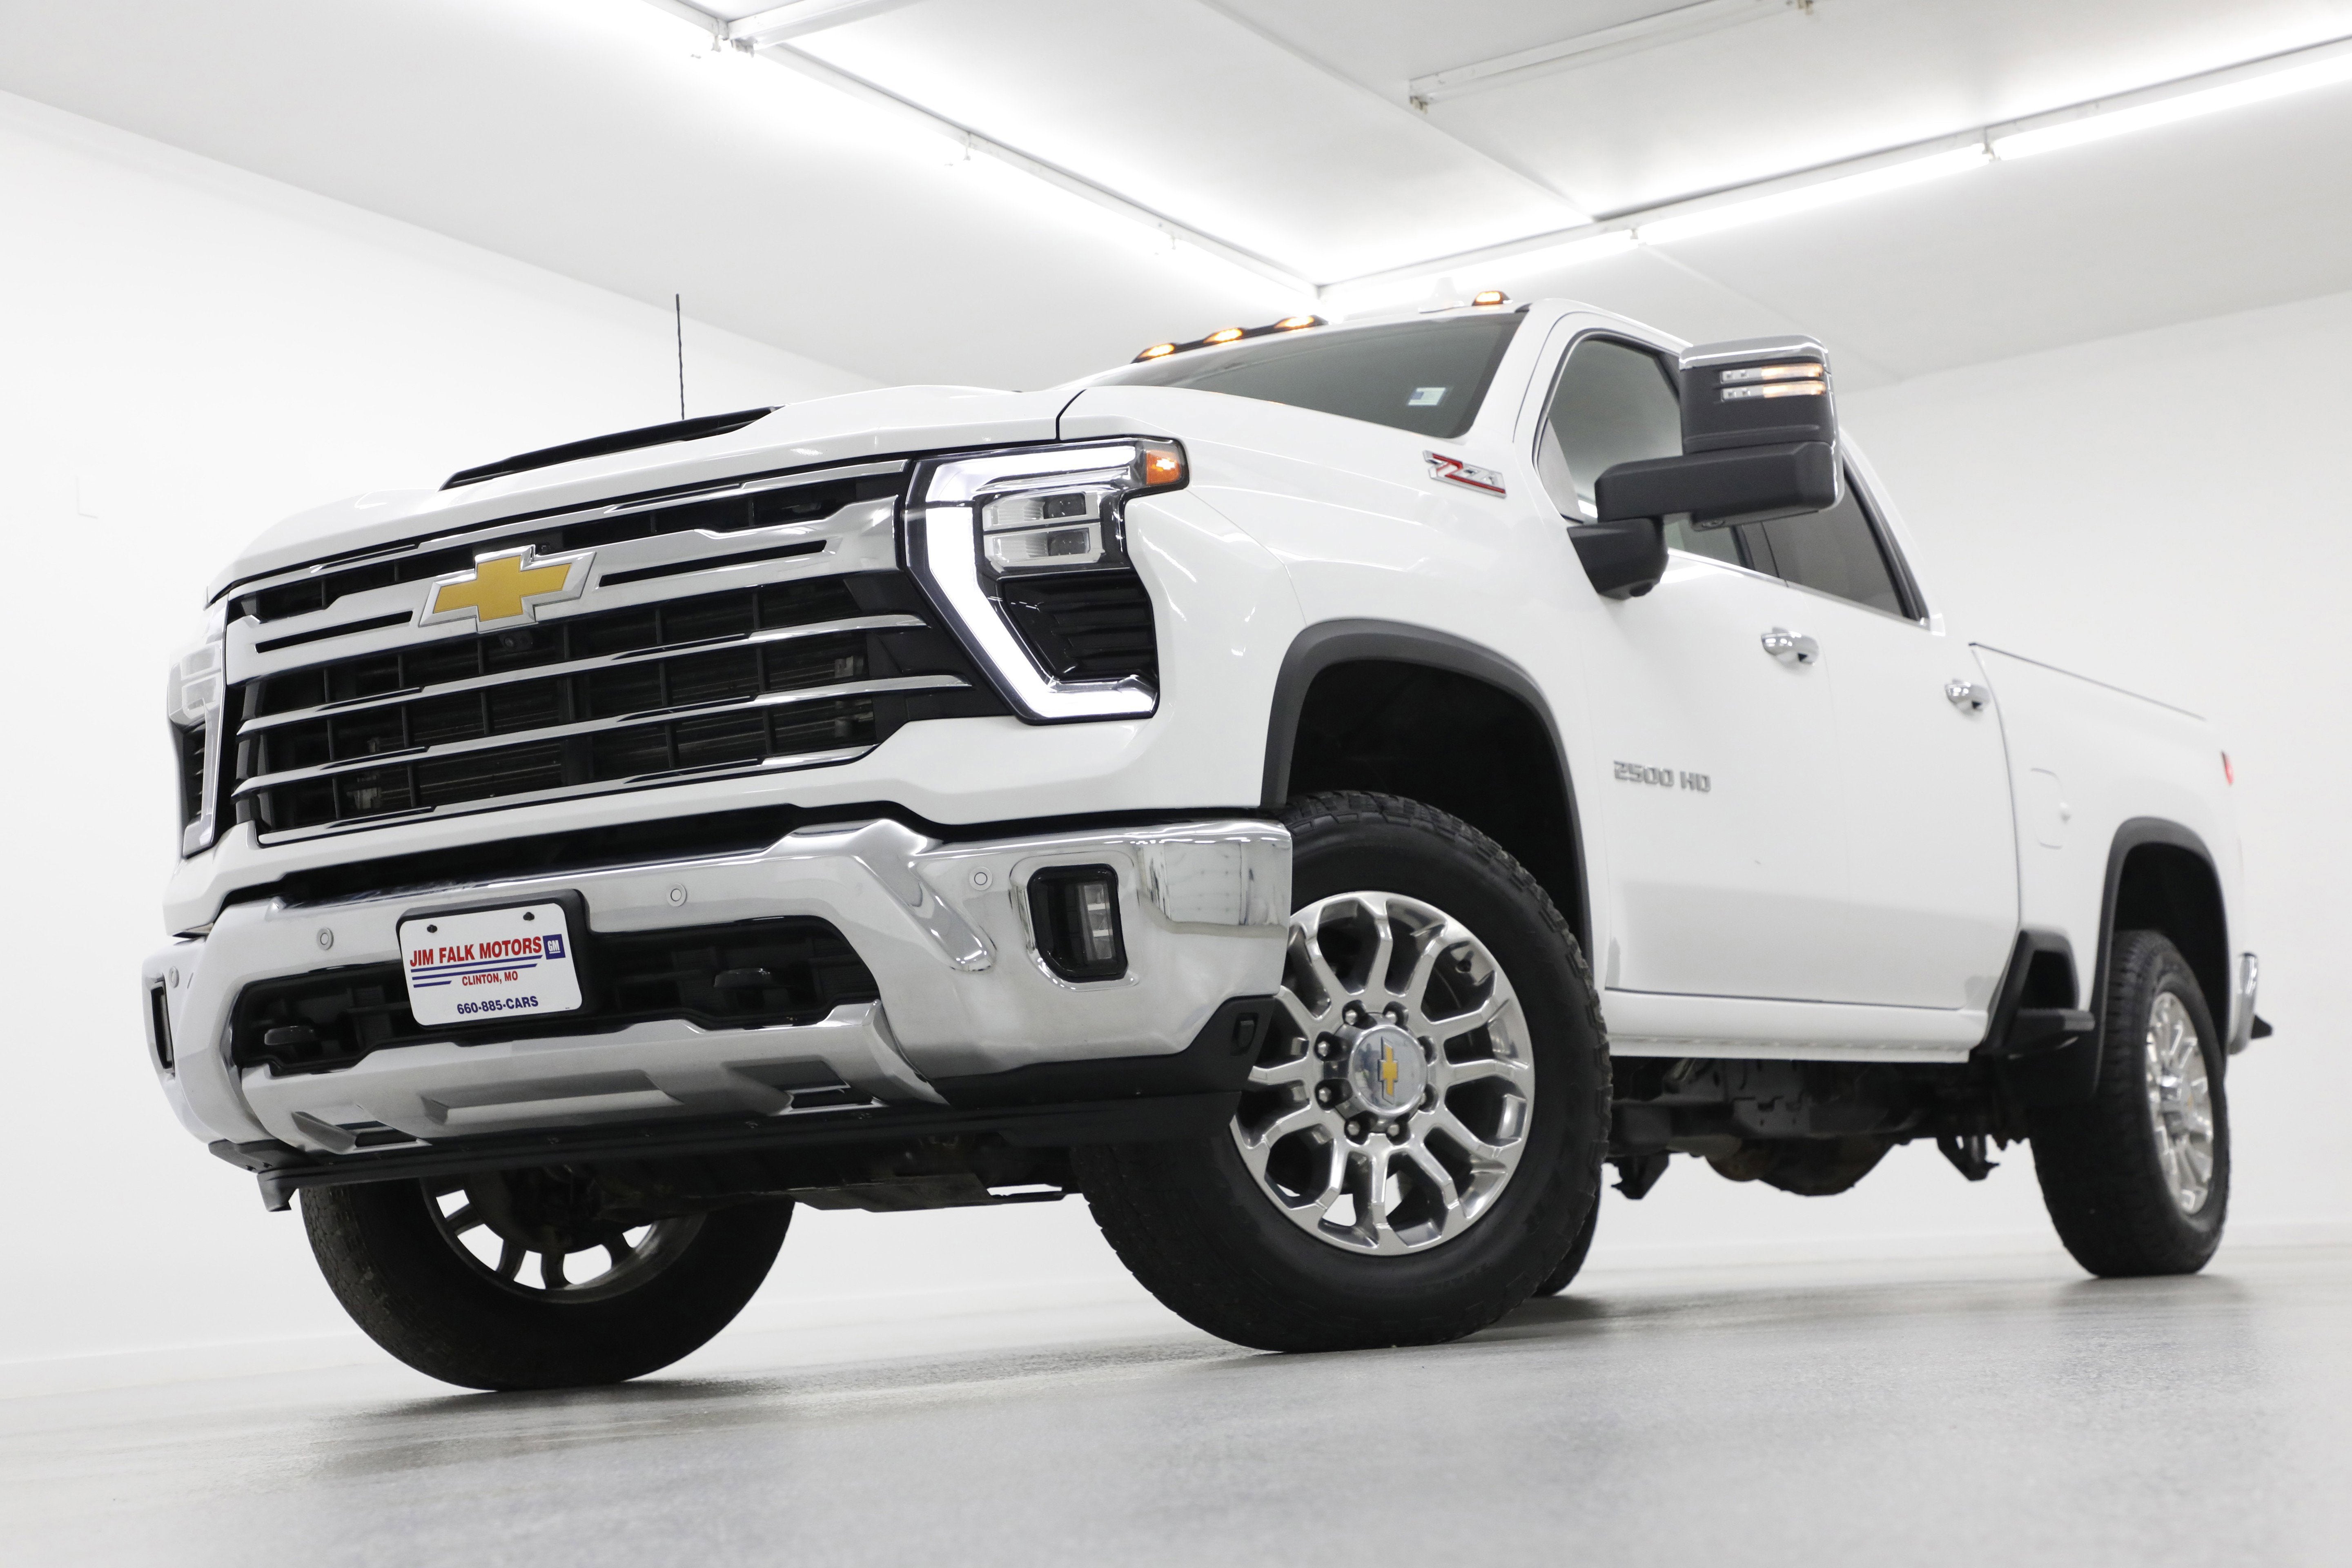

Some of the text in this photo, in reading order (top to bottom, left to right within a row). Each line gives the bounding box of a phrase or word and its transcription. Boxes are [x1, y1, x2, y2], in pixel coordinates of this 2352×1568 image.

[1613, 760, 1711, 793] 2500 HD
[410, 936, 542, 967] JIM FALK MOTORS
[547, 939, 560, 952] GM
[462, 971, 518, 986] CLINTON, MO
[457, 995, 539, 1015] 660-885-CARS
